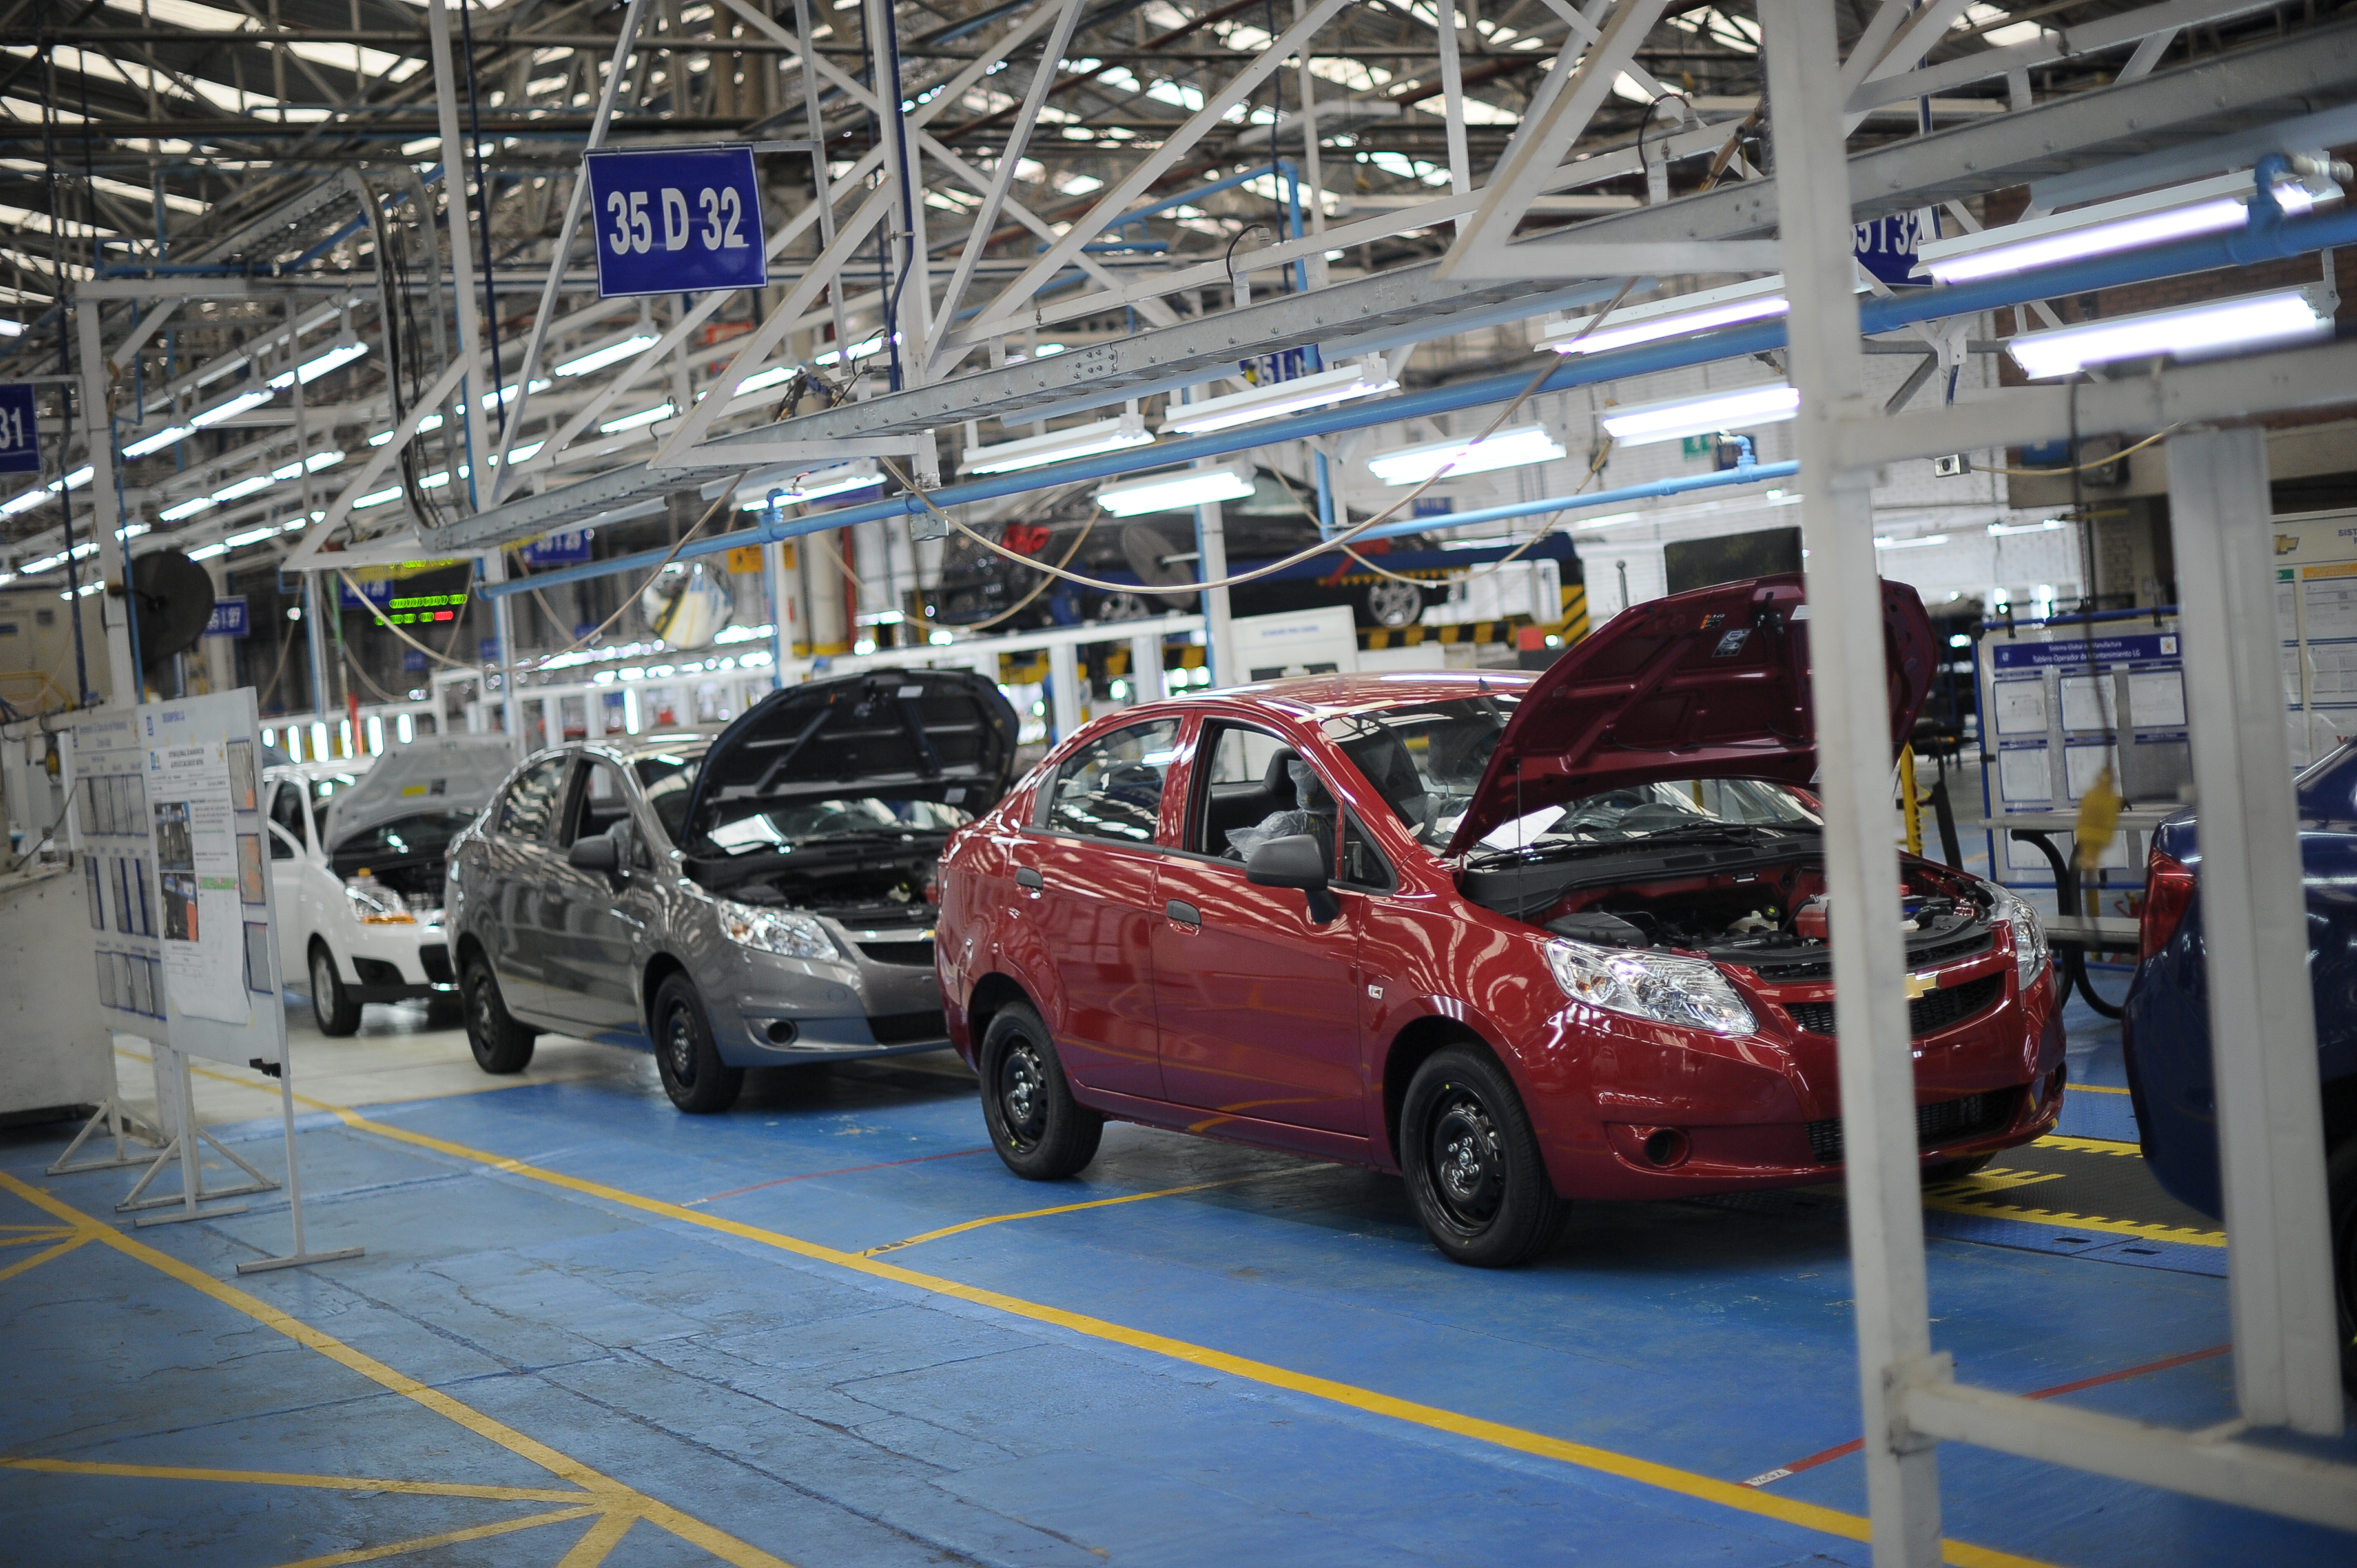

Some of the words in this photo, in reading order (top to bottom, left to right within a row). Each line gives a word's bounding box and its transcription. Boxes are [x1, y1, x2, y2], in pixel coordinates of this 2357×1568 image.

[607, 190, 652, 255] 35
[661, 188, 689, 251] D
[699, 187, 749, 251] 32
[1895, 210, 1921, 255] 32
